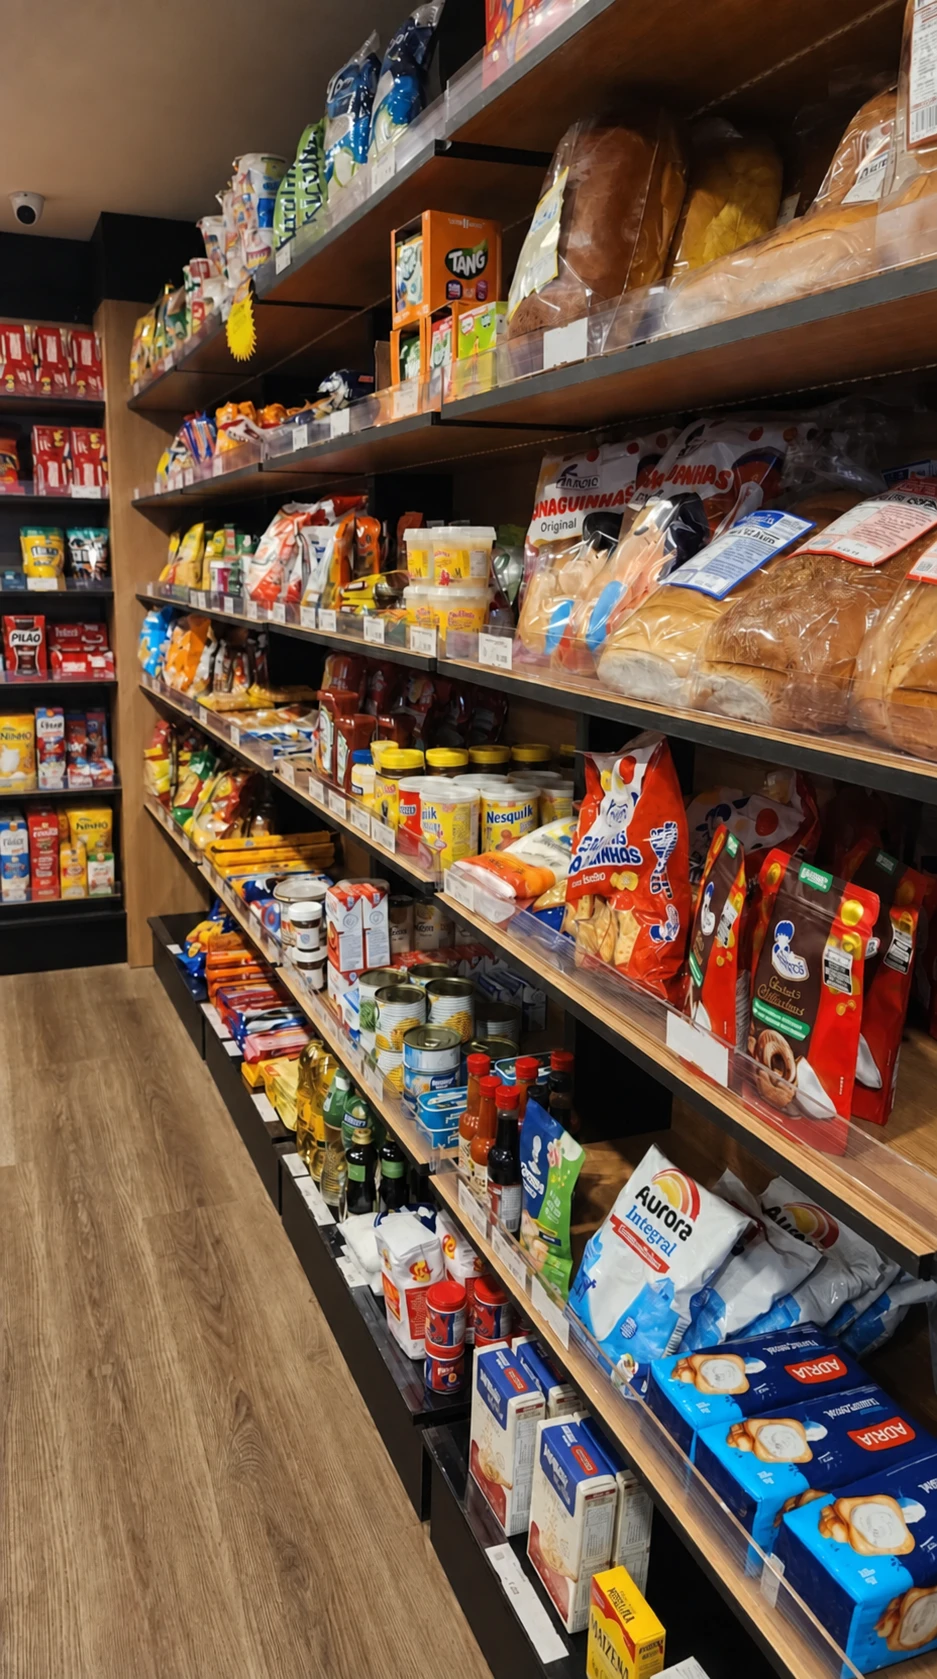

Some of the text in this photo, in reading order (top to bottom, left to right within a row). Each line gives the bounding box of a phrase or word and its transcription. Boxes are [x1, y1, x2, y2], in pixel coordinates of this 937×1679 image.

[448, 250, 486, 276] TANG
[540, 517, 577, 535] Original
[634, 1185, 693, 1242] Aurora
[625, 1204, 678, 1258] Integral
[792, 1358, 841, 1379] ADRIA
[857, 1421, 907, 1446] ADRIA
